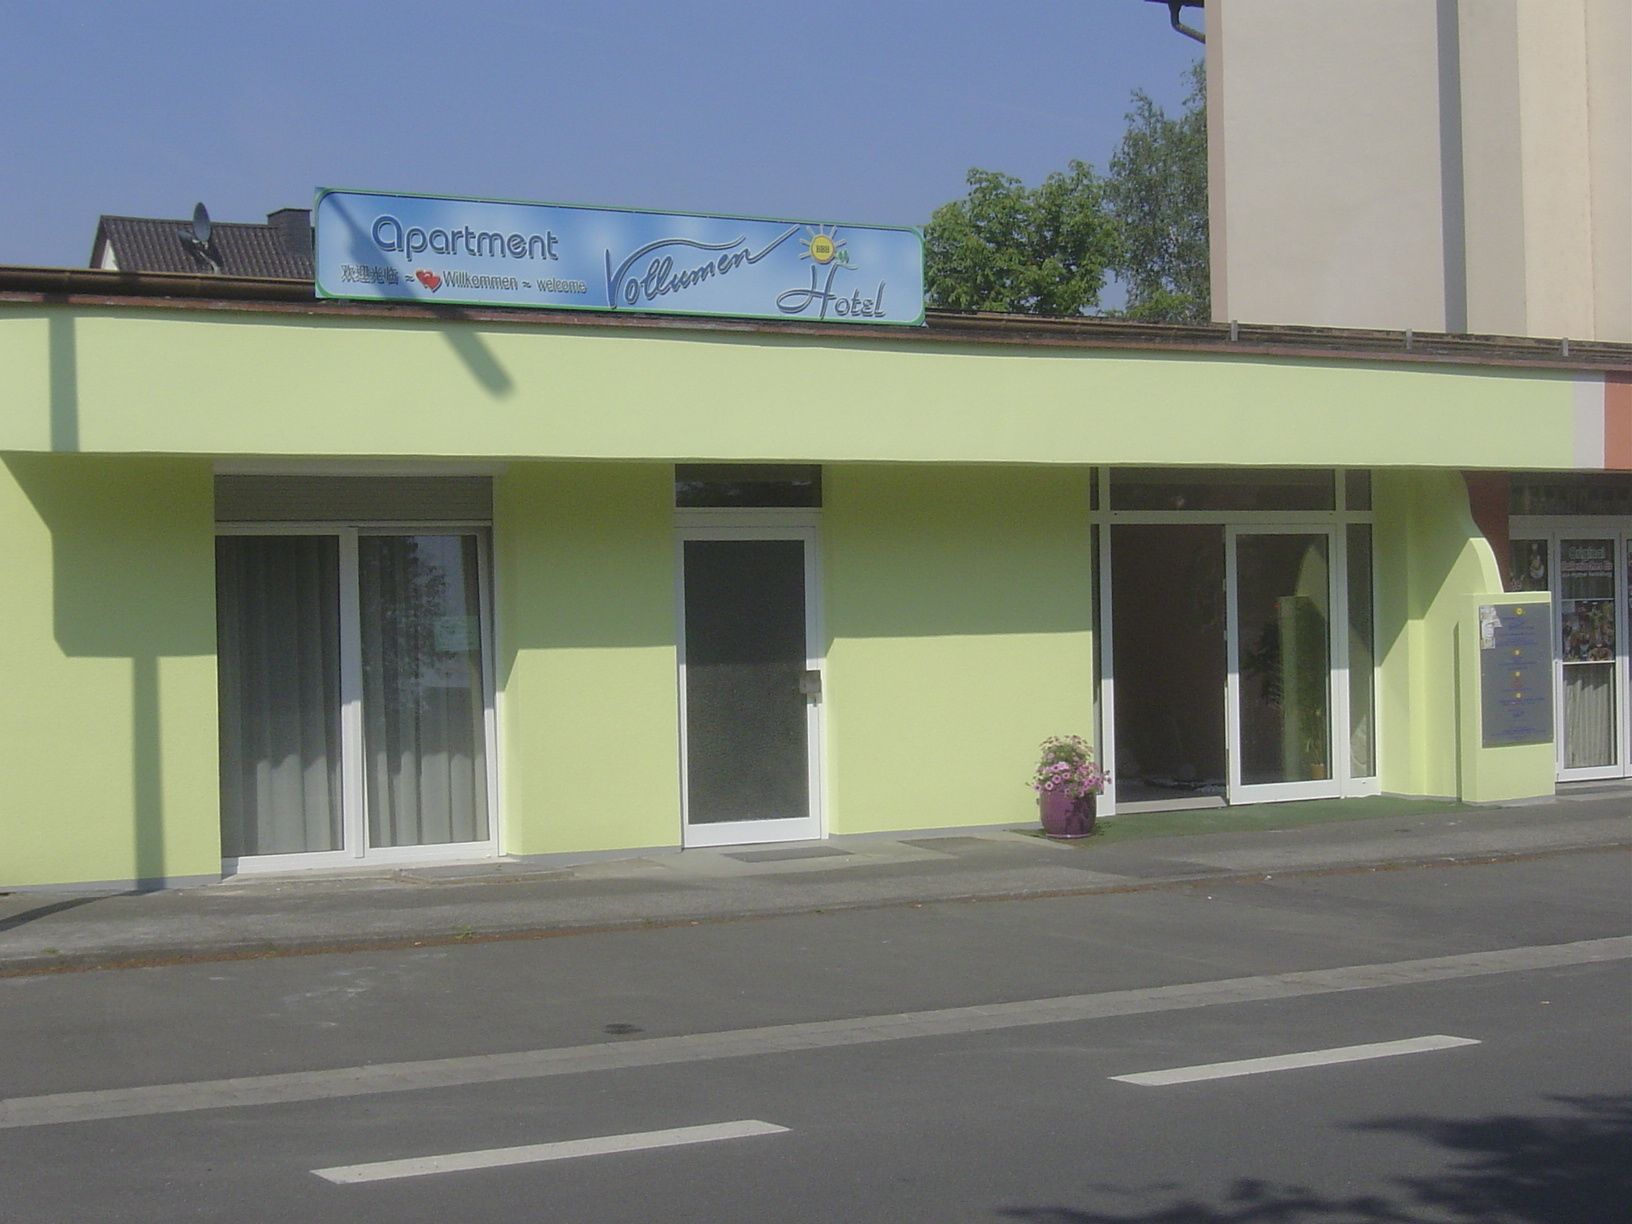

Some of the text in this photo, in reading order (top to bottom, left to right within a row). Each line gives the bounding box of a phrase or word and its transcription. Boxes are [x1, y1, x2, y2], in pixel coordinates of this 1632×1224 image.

[442, 270, 587, 294] Willkommen welcome
[776, 262, 886, 320] Hotel
